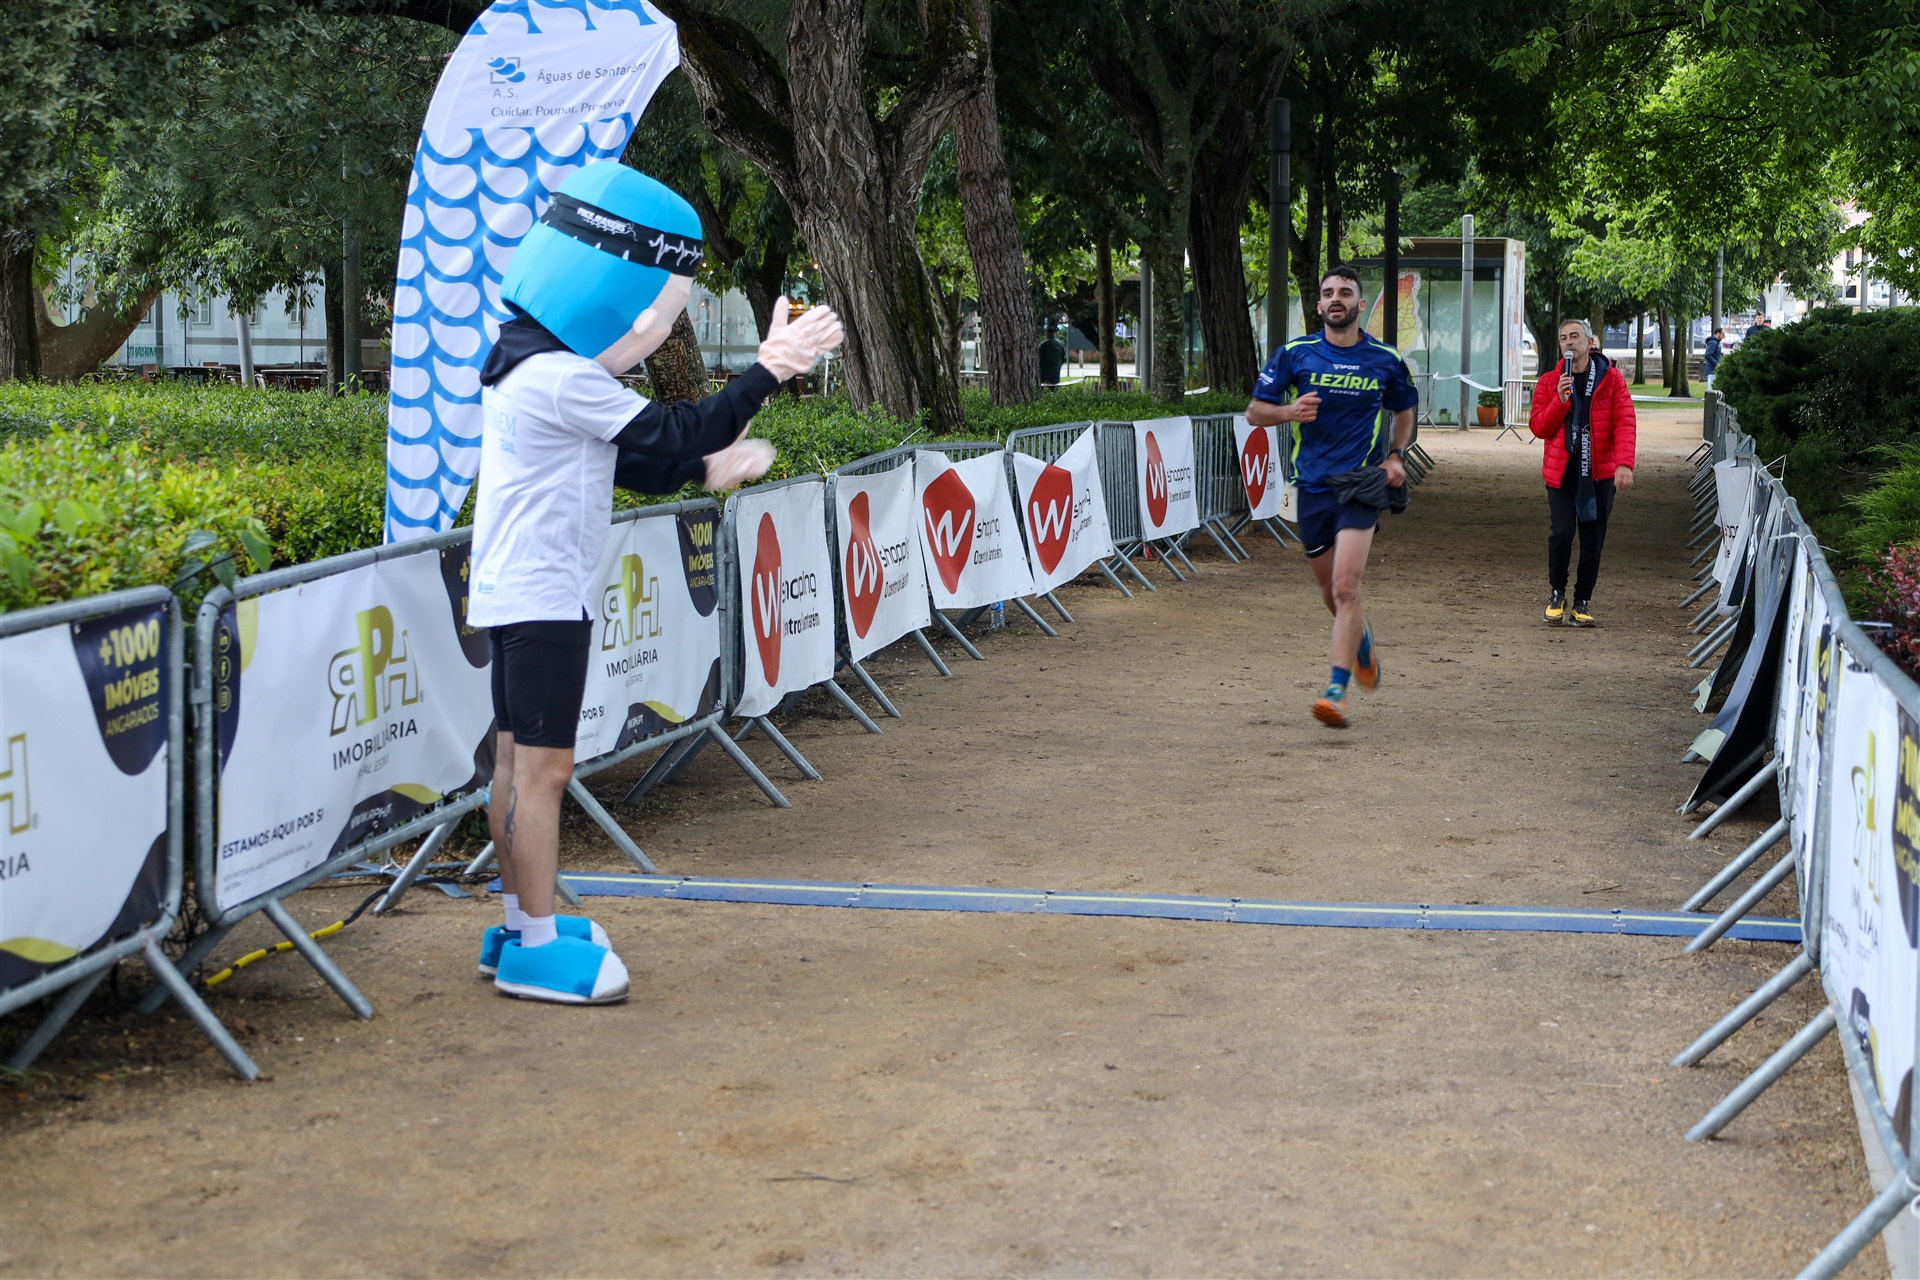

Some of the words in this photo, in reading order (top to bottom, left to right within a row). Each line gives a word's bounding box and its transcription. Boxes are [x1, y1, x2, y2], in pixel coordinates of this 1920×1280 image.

[537, 69, 573, 84] Águas
[577, 69, 591, 80] de
[491, 106, 532, 118] Cuidar.
[535, 106, 578, 117] Poupar.
[1310, 372, 1379, 390] LEZÍRIA
[99, 618, 160, 669] +1000
[104, 668, 160, 711] IMÓVEIS
[582, 707, 598, 721] POR
[222, 829, 270, 860] ESTAMOS
[271, 820, 296, 841] AQUI
[297, 812, 315, 832] POR
